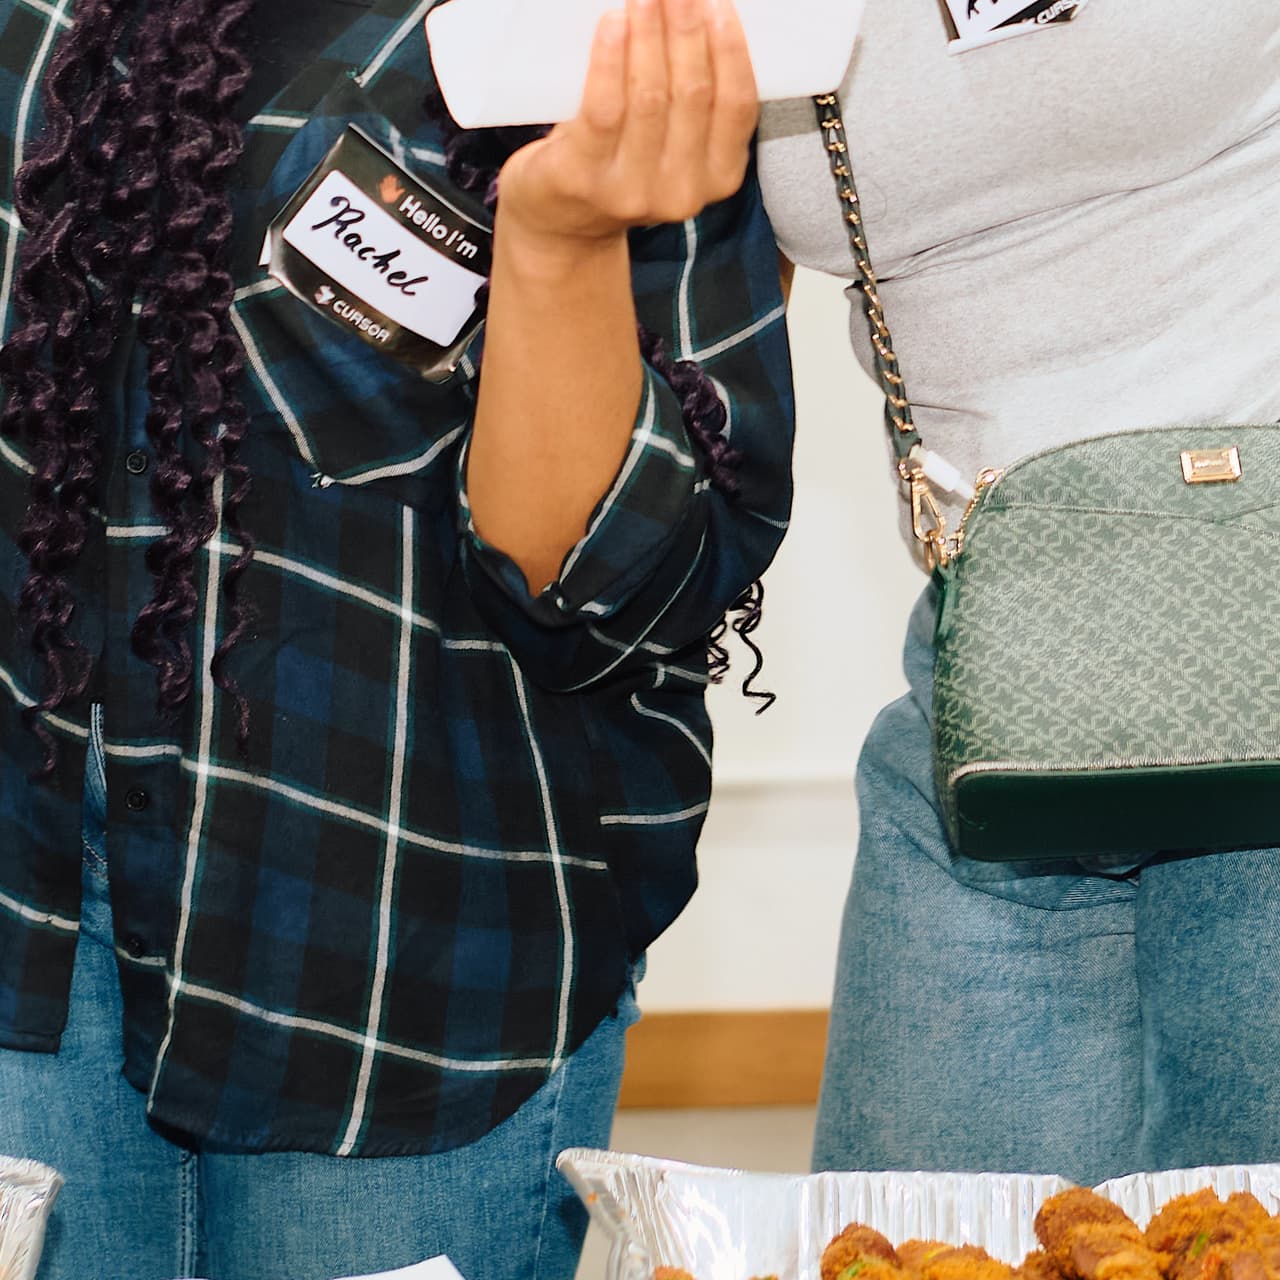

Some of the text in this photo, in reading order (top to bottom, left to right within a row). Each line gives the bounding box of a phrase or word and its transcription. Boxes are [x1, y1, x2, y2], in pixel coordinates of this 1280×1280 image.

[311, 196, 429, 296] Rachel
[398, 194, 479, 259] Hello I'm
[332, 299, 391, 343] CURSOR
